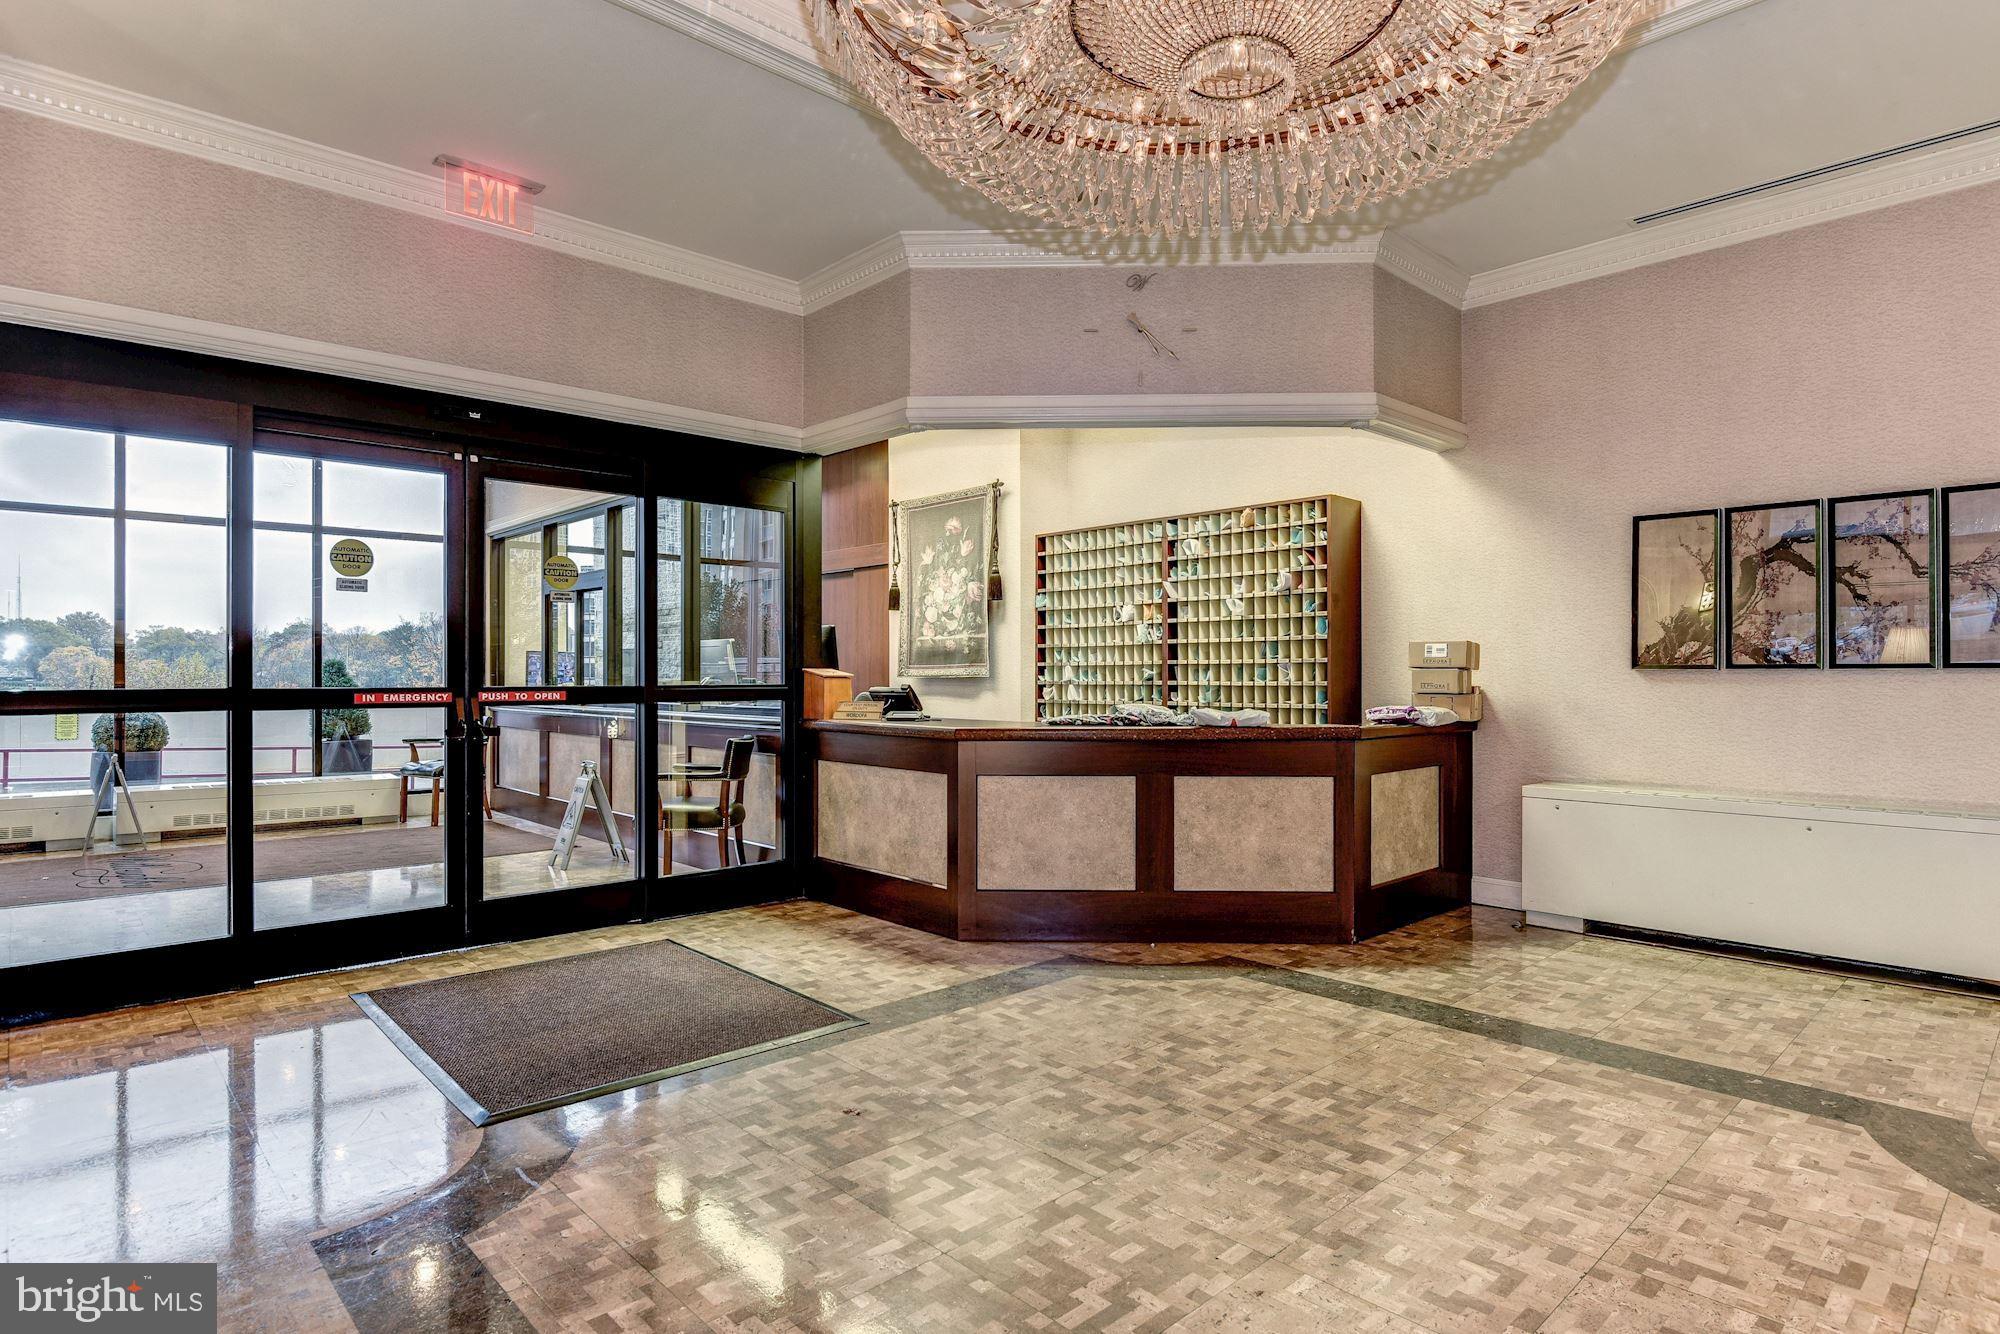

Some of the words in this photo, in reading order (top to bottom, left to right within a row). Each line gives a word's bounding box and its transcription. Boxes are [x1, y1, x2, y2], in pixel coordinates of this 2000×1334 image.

[463, 171, 519, 225] EXIT
[331, 554, 372, 563] CAUTION
[545, 569, 578, 577] CAUTION
[362, 694, 375, 702] IN
[383, 693, 449, 702] EMERGENCY
[482, 692, 509, 700] PUSH
[515, 692, 528, 700] TO
[534, 691, 560, 700] OPEN
